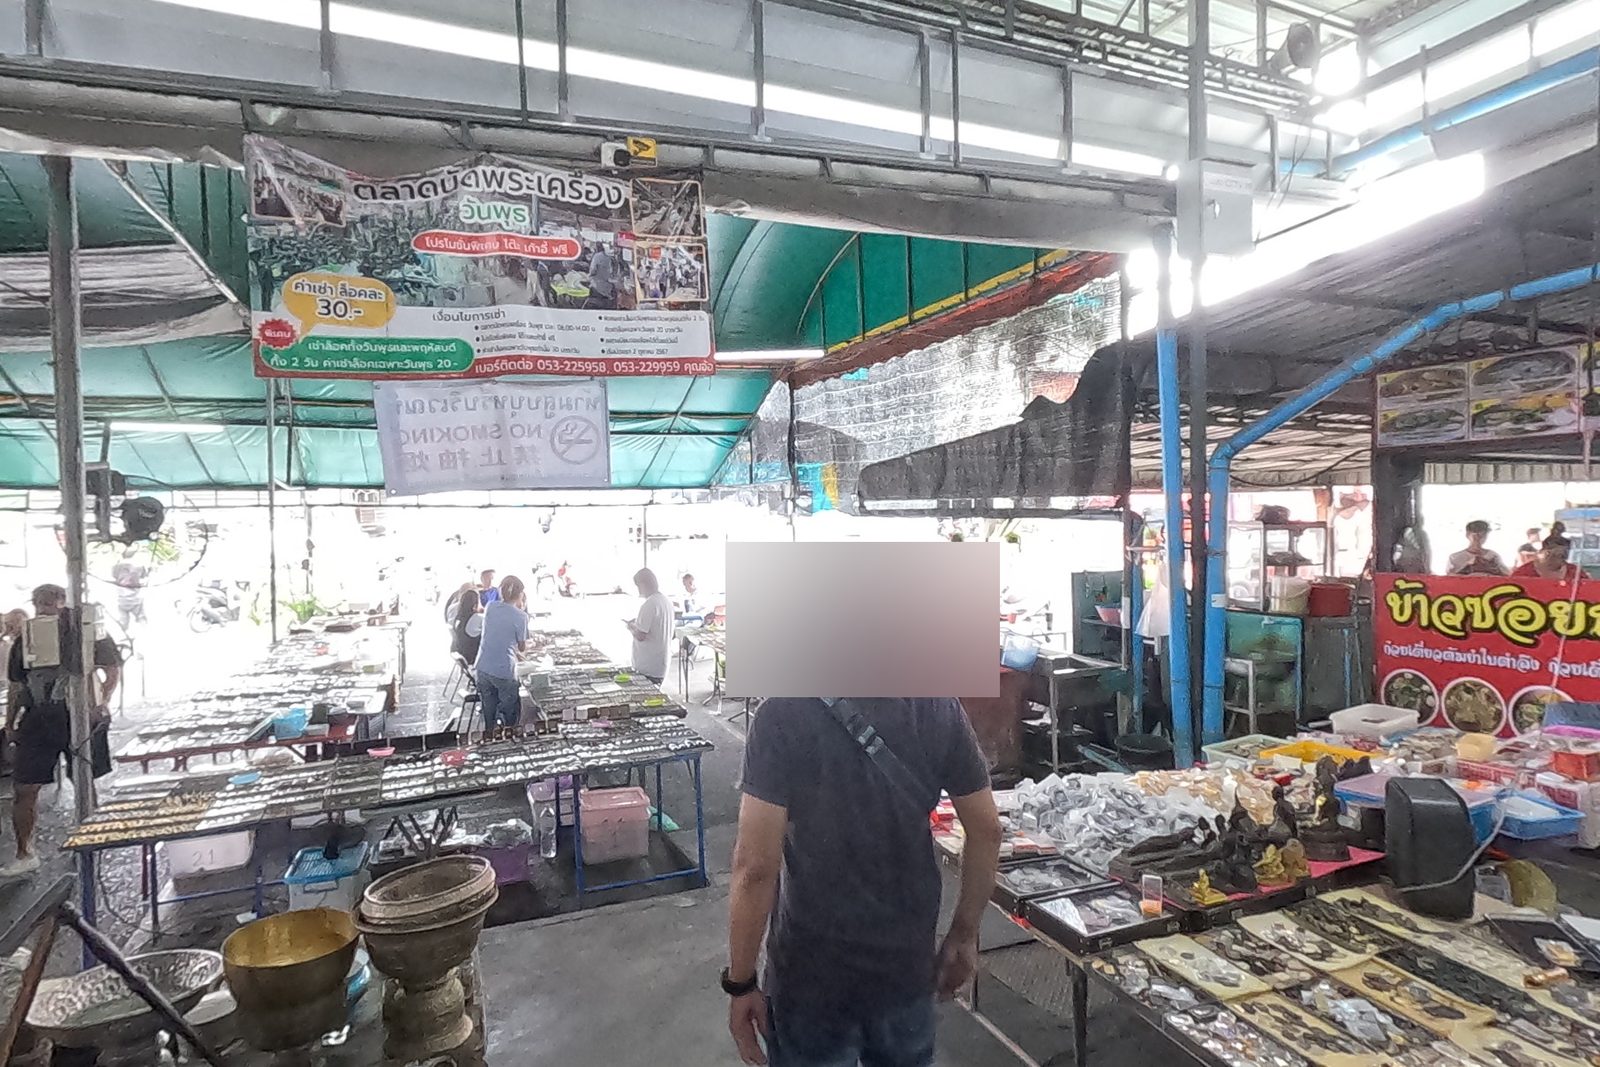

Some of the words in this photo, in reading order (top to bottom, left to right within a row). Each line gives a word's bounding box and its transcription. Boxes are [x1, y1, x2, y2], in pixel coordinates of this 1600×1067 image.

[460, 196, 527, 226] วันพุธ
[552, 243, 568, 255] ฟรี
[294, 280, 334, 296] ค่าเช่า
[339, 282, 384, 300] ล็อคละ
[317, 299, 363, 318] 30.-
[432, 309, 506, 322] เงื่อนไขการเช่า
[292, 357, 299, 367] 2
[304, 357, 318, 367] วัน
[475, 357, 533, 373] เบอร์ติดต่อ
[192, 848, 214, 866] 21
